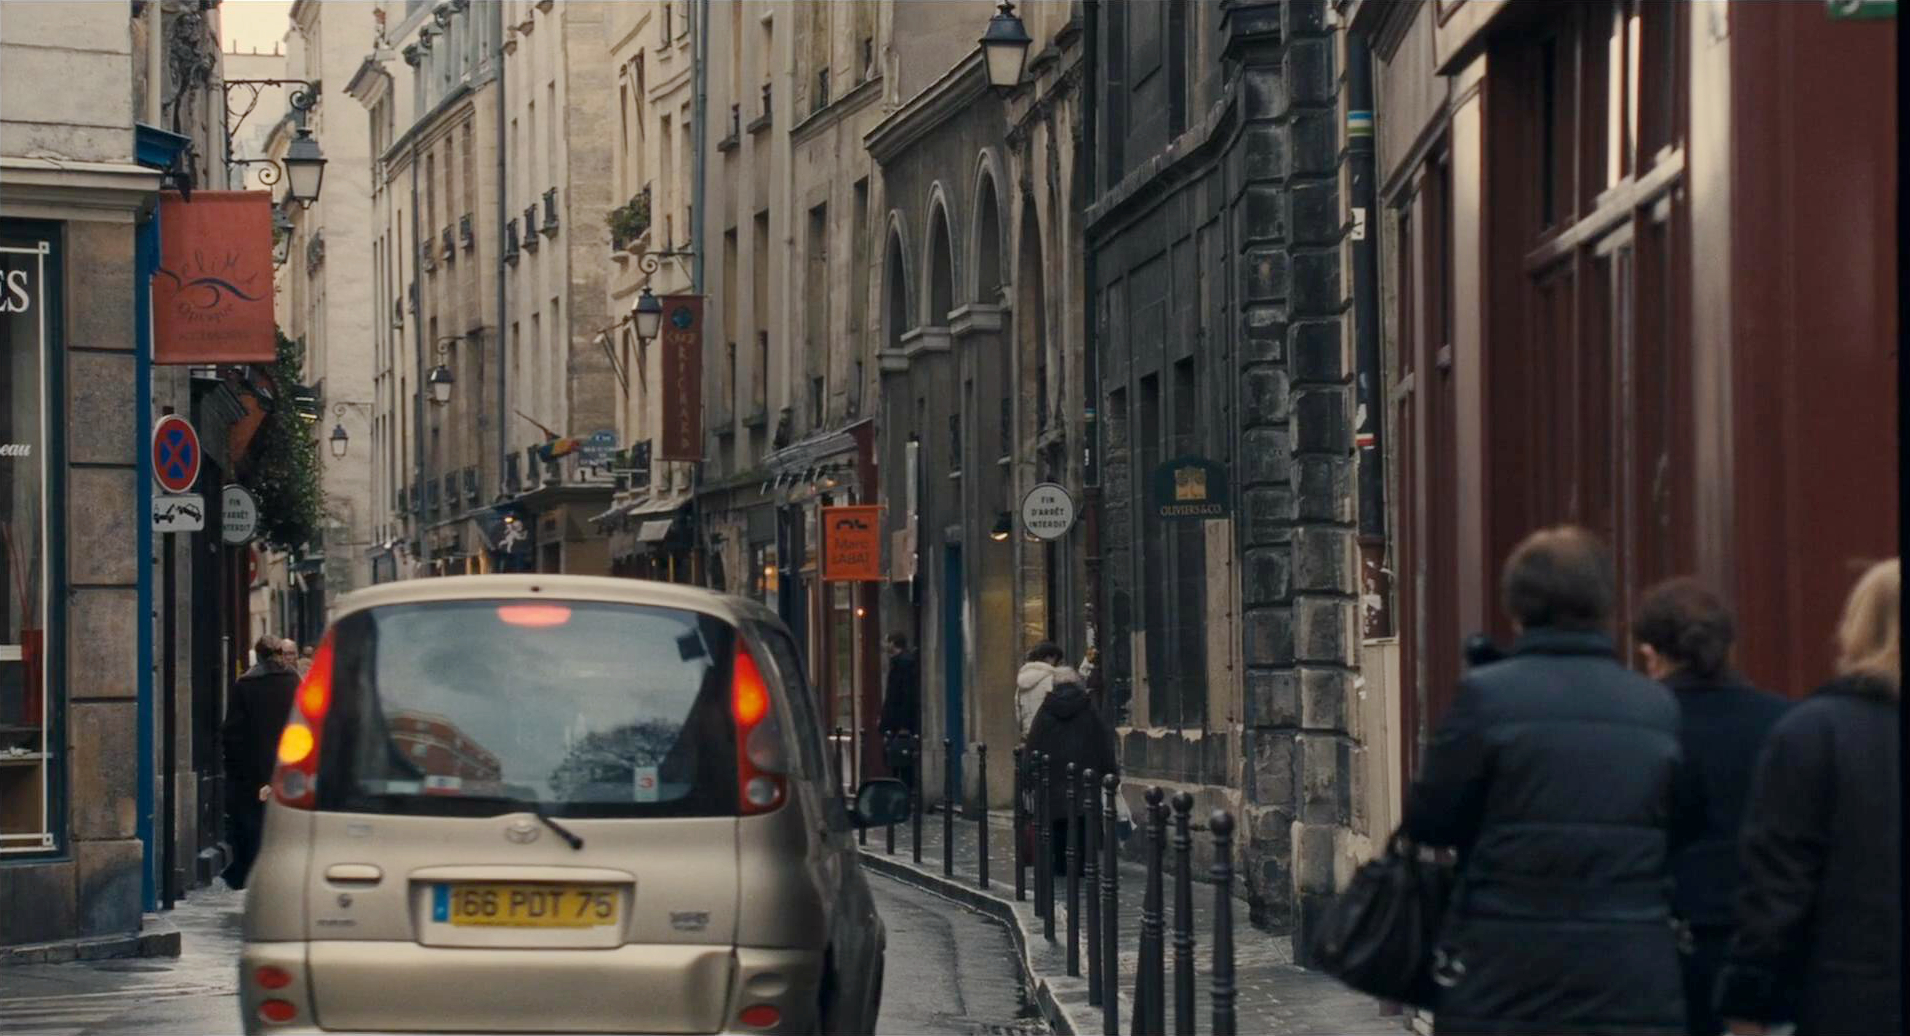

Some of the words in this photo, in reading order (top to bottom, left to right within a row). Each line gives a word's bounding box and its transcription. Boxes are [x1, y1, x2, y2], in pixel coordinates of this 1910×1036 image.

[229, 498, 241, 506] FIN
[1041, 496, 1055, 504] FIN
[1031, 507, 1065, 516] D'ARRÊT
[1028, 520, 1067, 528] INTERDIT
[453, 889, 499, 917] 166
[574, 891, 613, 921] 75
